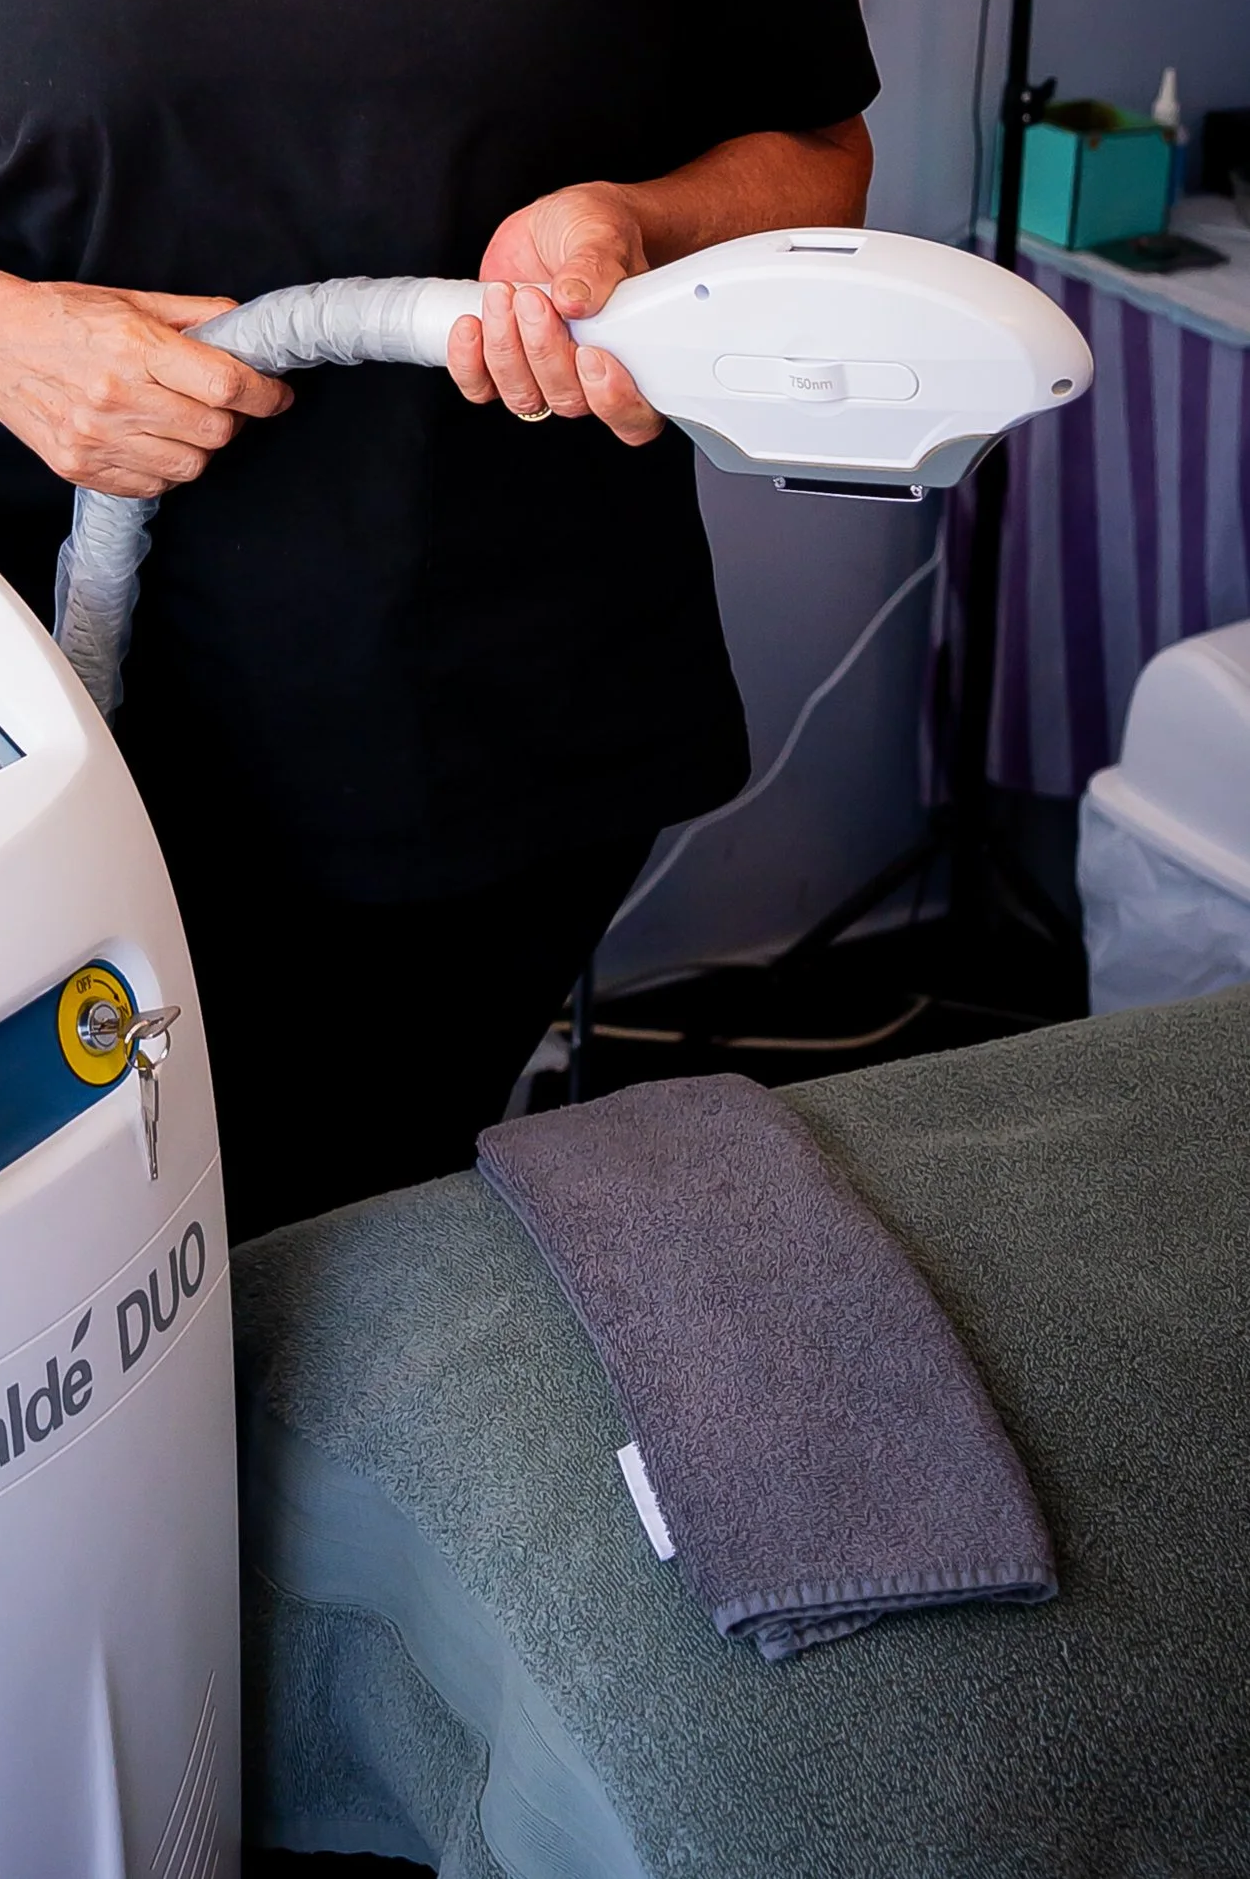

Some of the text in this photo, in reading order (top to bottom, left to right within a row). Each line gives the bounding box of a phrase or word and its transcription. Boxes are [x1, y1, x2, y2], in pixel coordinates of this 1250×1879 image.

[788, 374, 834, 391] 750nm
[75, 973, 92, 995] OFF
[115, 1219, 206, 1374] DUO
